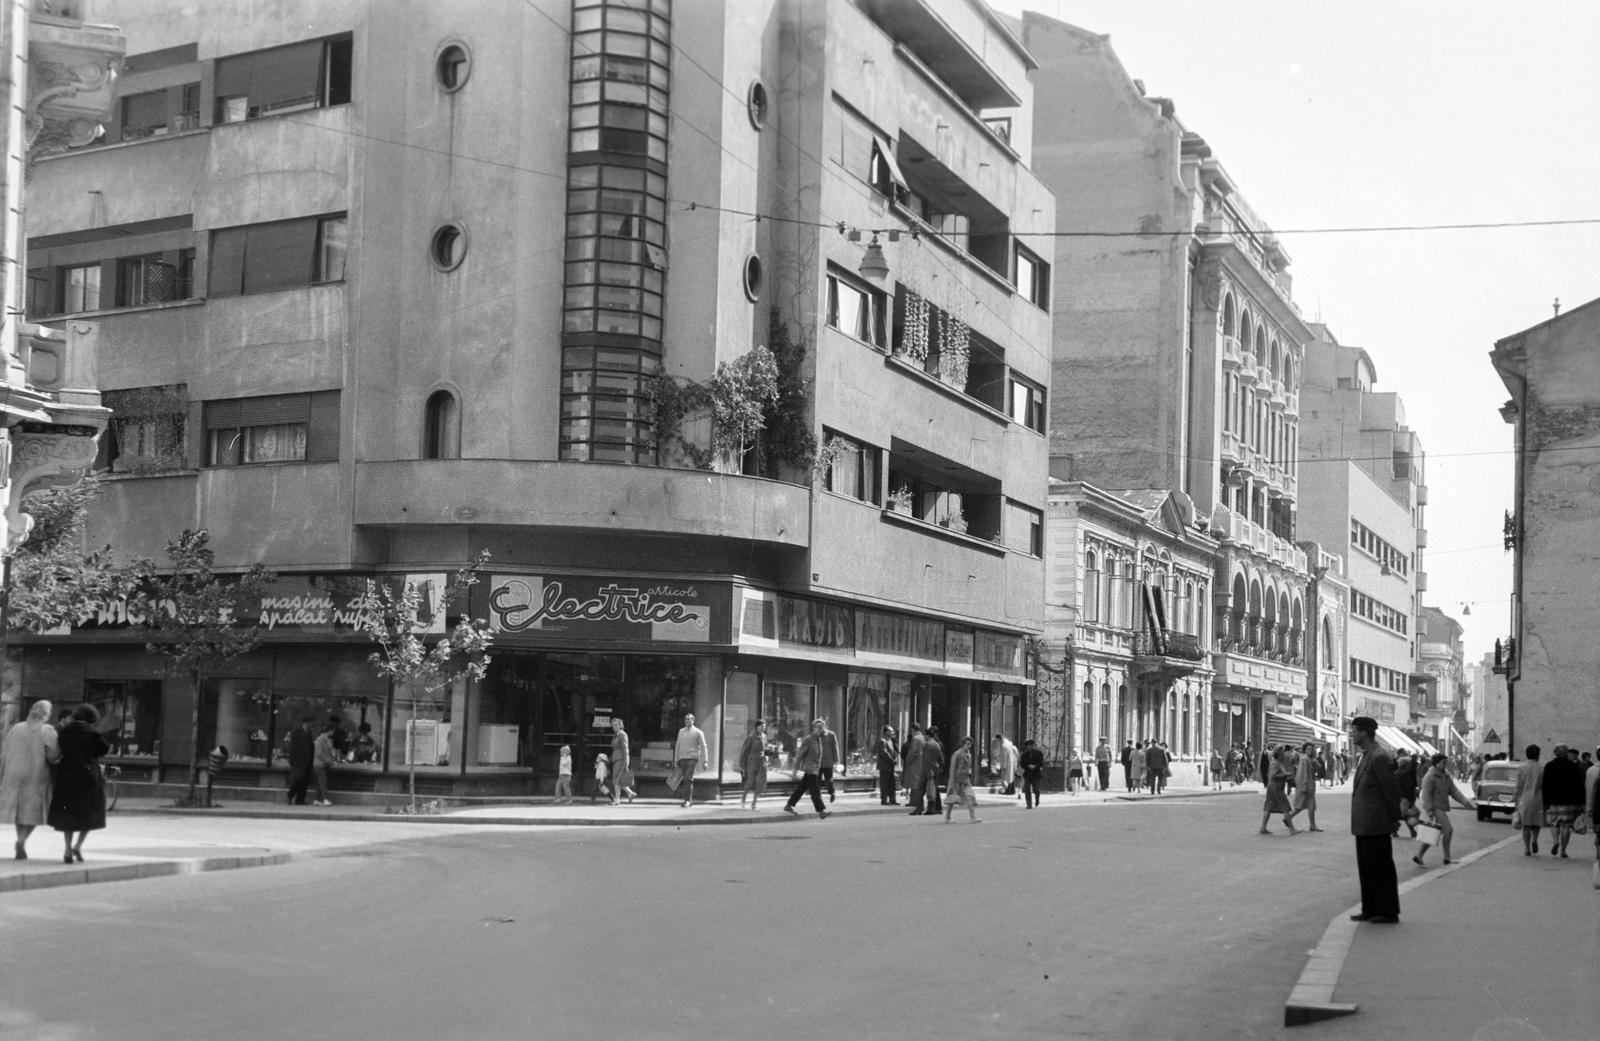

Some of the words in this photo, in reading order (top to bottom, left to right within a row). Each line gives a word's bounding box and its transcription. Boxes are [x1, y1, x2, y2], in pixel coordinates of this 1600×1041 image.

[489, 582, 699, 632] Electrice
[648, 585, 697, 598] articole
[788, 615, 844, 646] RADIO
